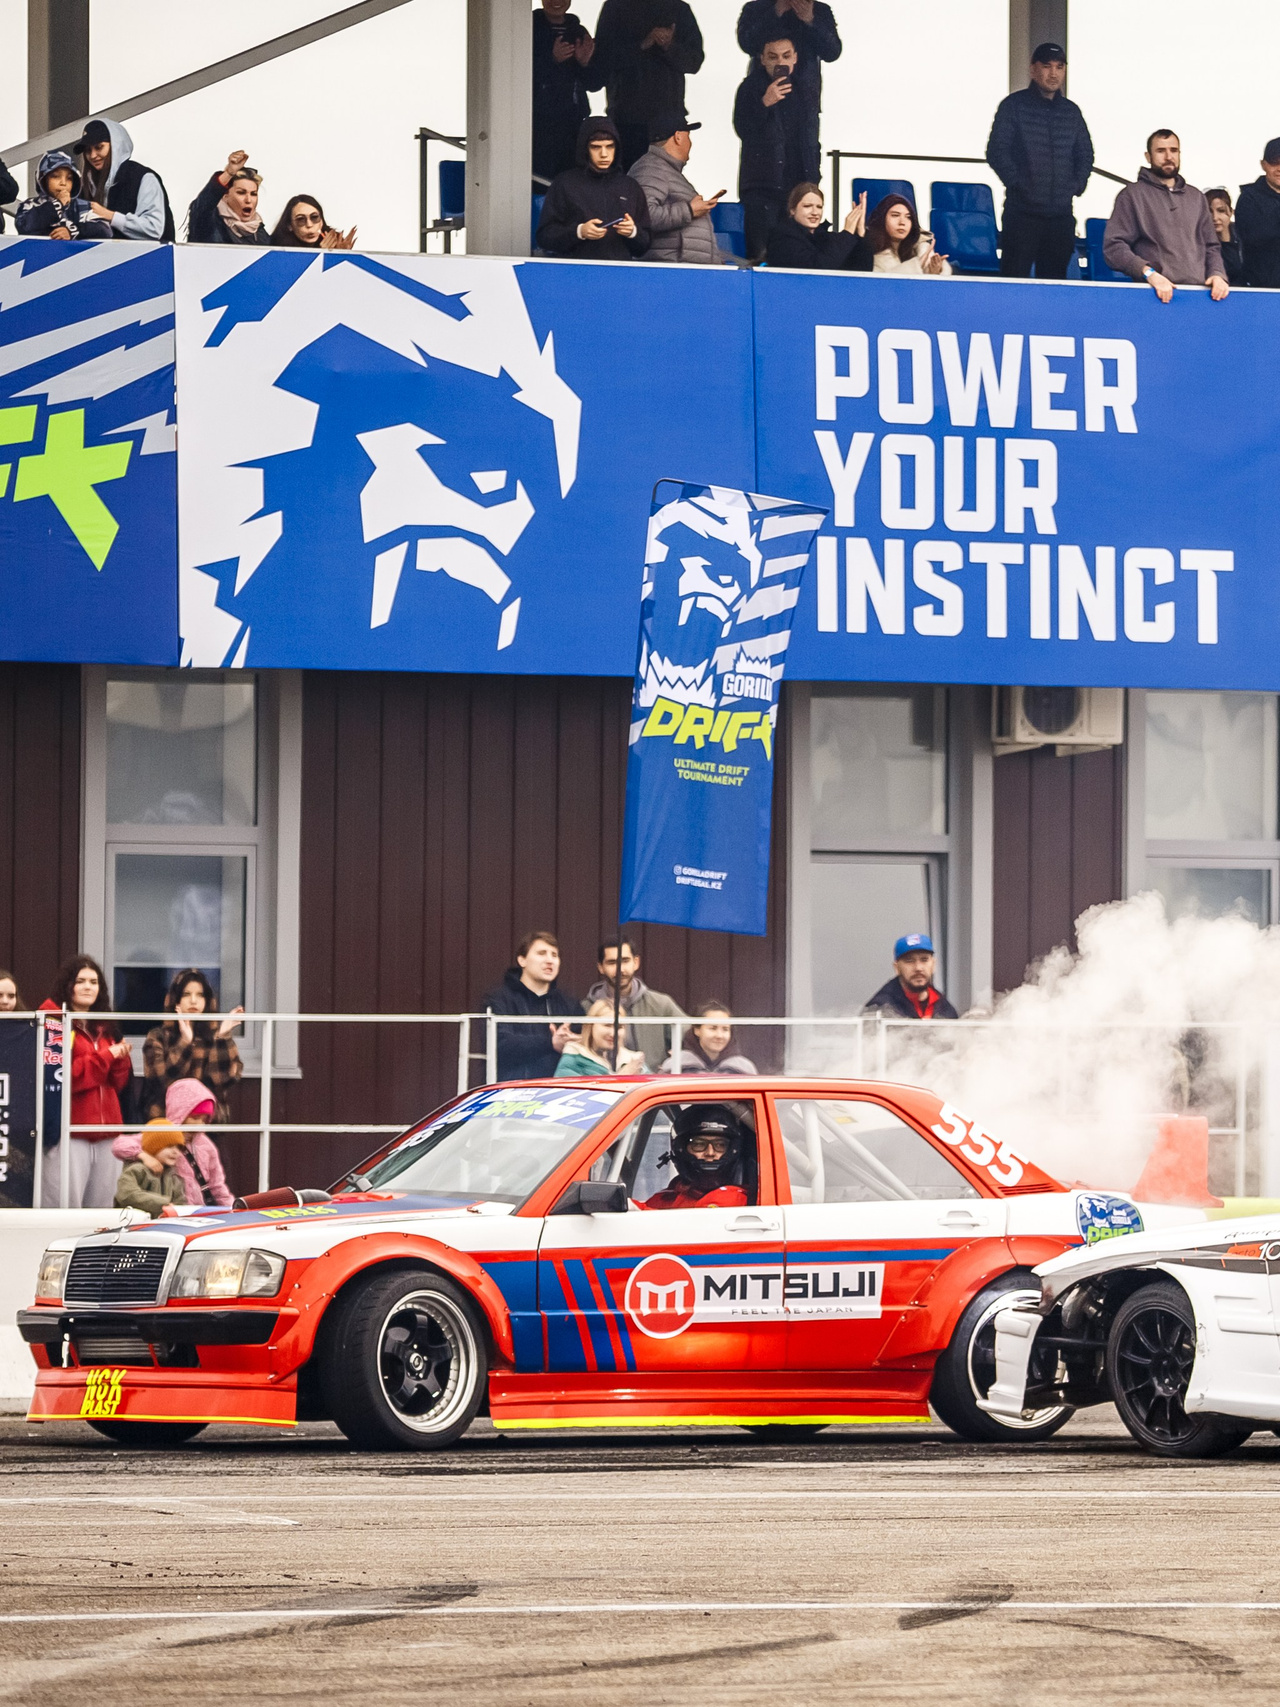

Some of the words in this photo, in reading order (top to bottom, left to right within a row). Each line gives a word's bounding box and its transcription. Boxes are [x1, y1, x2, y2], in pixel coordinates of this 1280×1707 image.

[814, 324, 1139, 434] POWER
[813, 429, 1058, 535] YOUR
[815, 535, 1235, 645] INSTINCT
[722, 673, 773, 702] GORILL
[673, 758, 716, 772] ULTIMATE
[718, 764, 750, 777] DRIFT
[677, 769, 744, 787] TOURNAMENT
[930, 1101, 1029, 1187] 555
[703, 1270, 876, 1302] MITSUJI
[731, 1308, 768, 1316] FEEL
[806, 1306, 854, 1315] JAPAN
[85, 1400, 120, 1415] PLAST
